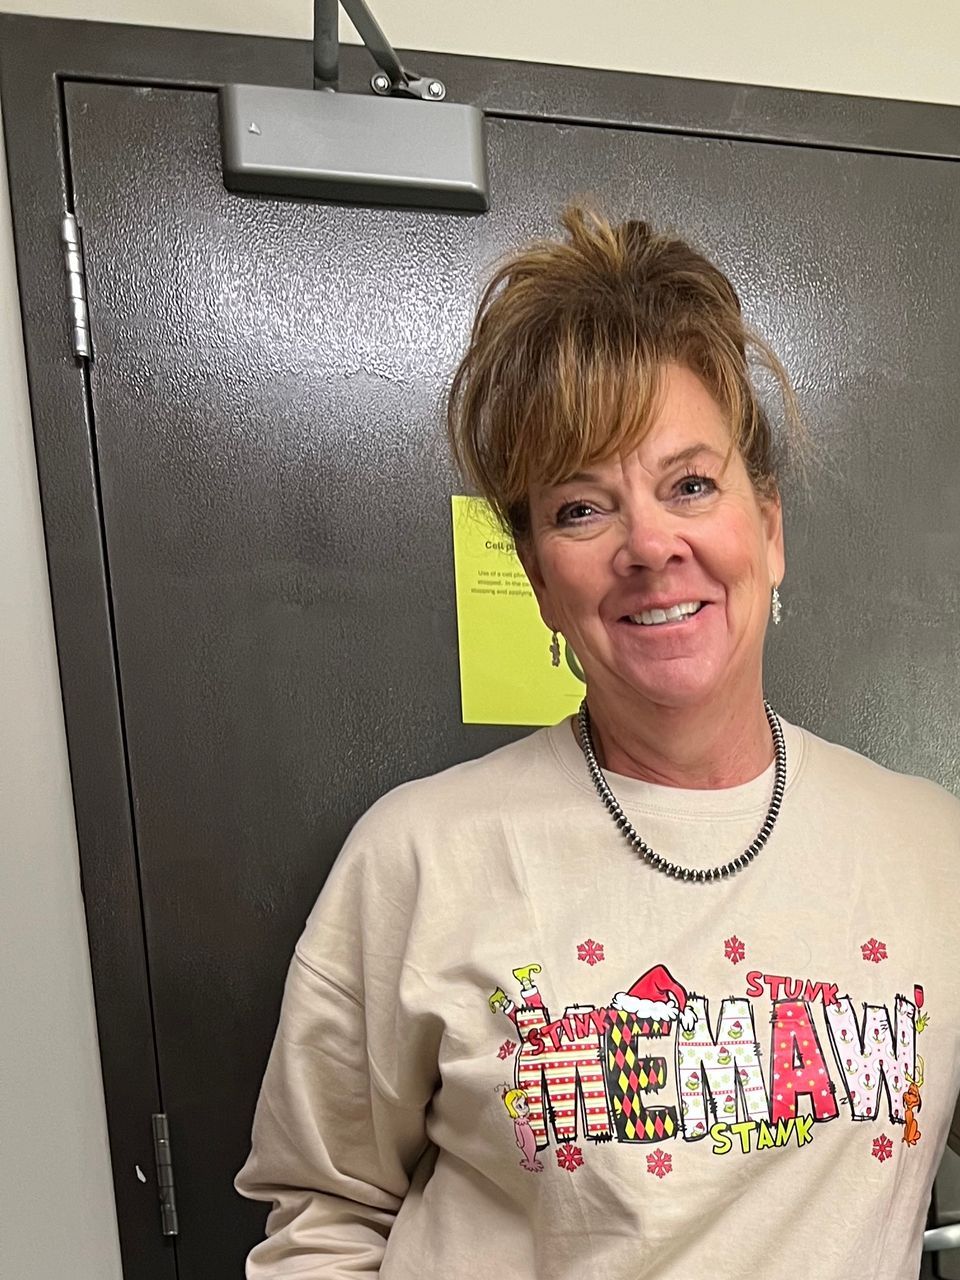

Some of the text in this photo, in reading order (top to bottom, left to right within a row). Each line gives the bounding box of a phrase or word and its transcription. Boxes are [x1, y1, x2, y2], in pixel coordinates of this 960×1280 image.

[485, 540, 504, 550] Cell
[745, 971, 839, 1007] STUNK
[527, 1006, 611, 1056] STINK
[514, 992, 916, 1150] MEMAW
[710, 1116, 813, 1156] STANK
